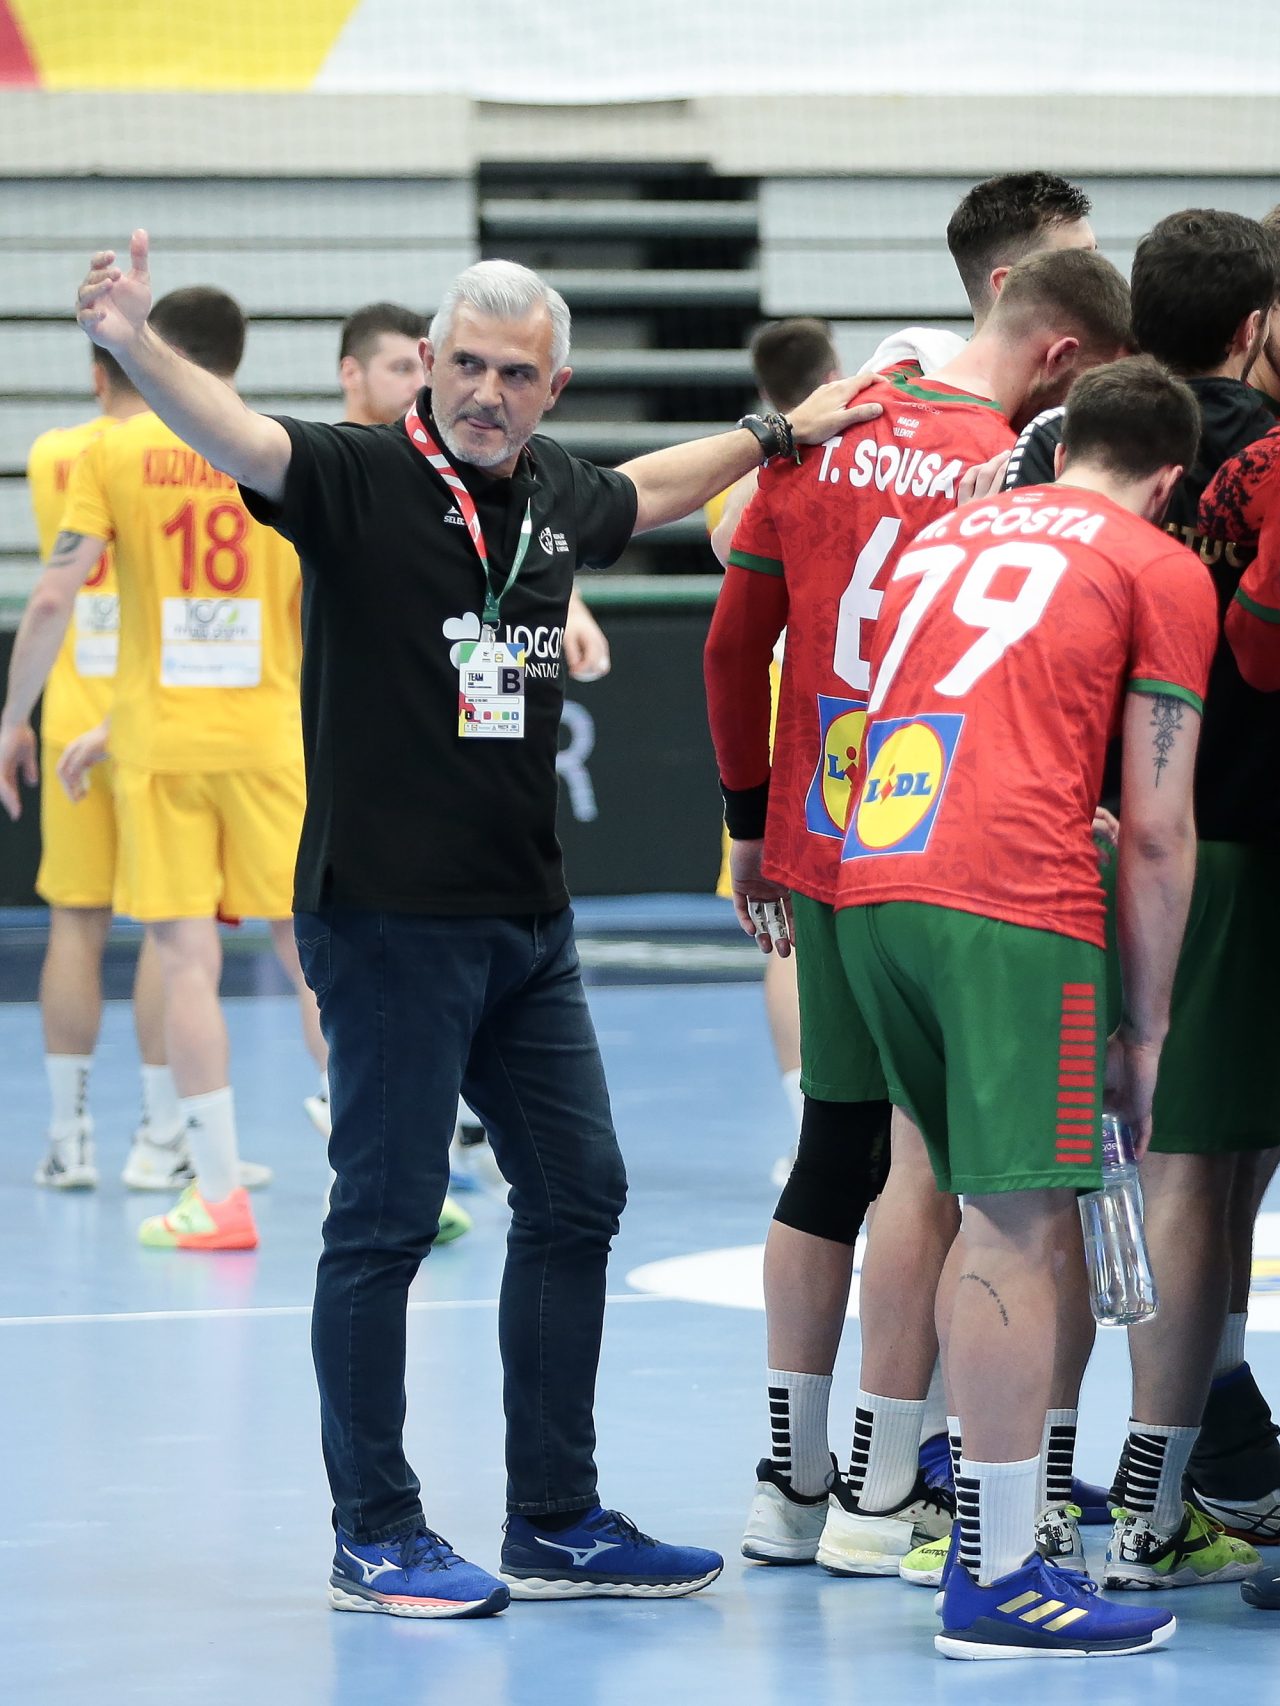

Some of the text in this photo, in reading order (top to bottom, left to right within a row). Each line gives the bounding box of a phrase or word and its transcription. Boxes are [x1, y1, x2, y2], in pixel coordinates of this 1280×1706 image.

[818, 436, 963, 499] T. SOUSA
[163, 499, 247, 591] 18
[444, 515, 467, 526] SELEC
[959, 506, 1105, 544] COSTA
[866, 541, 1068, 714] 79
[467, 668, 520, 693] TEAM B
